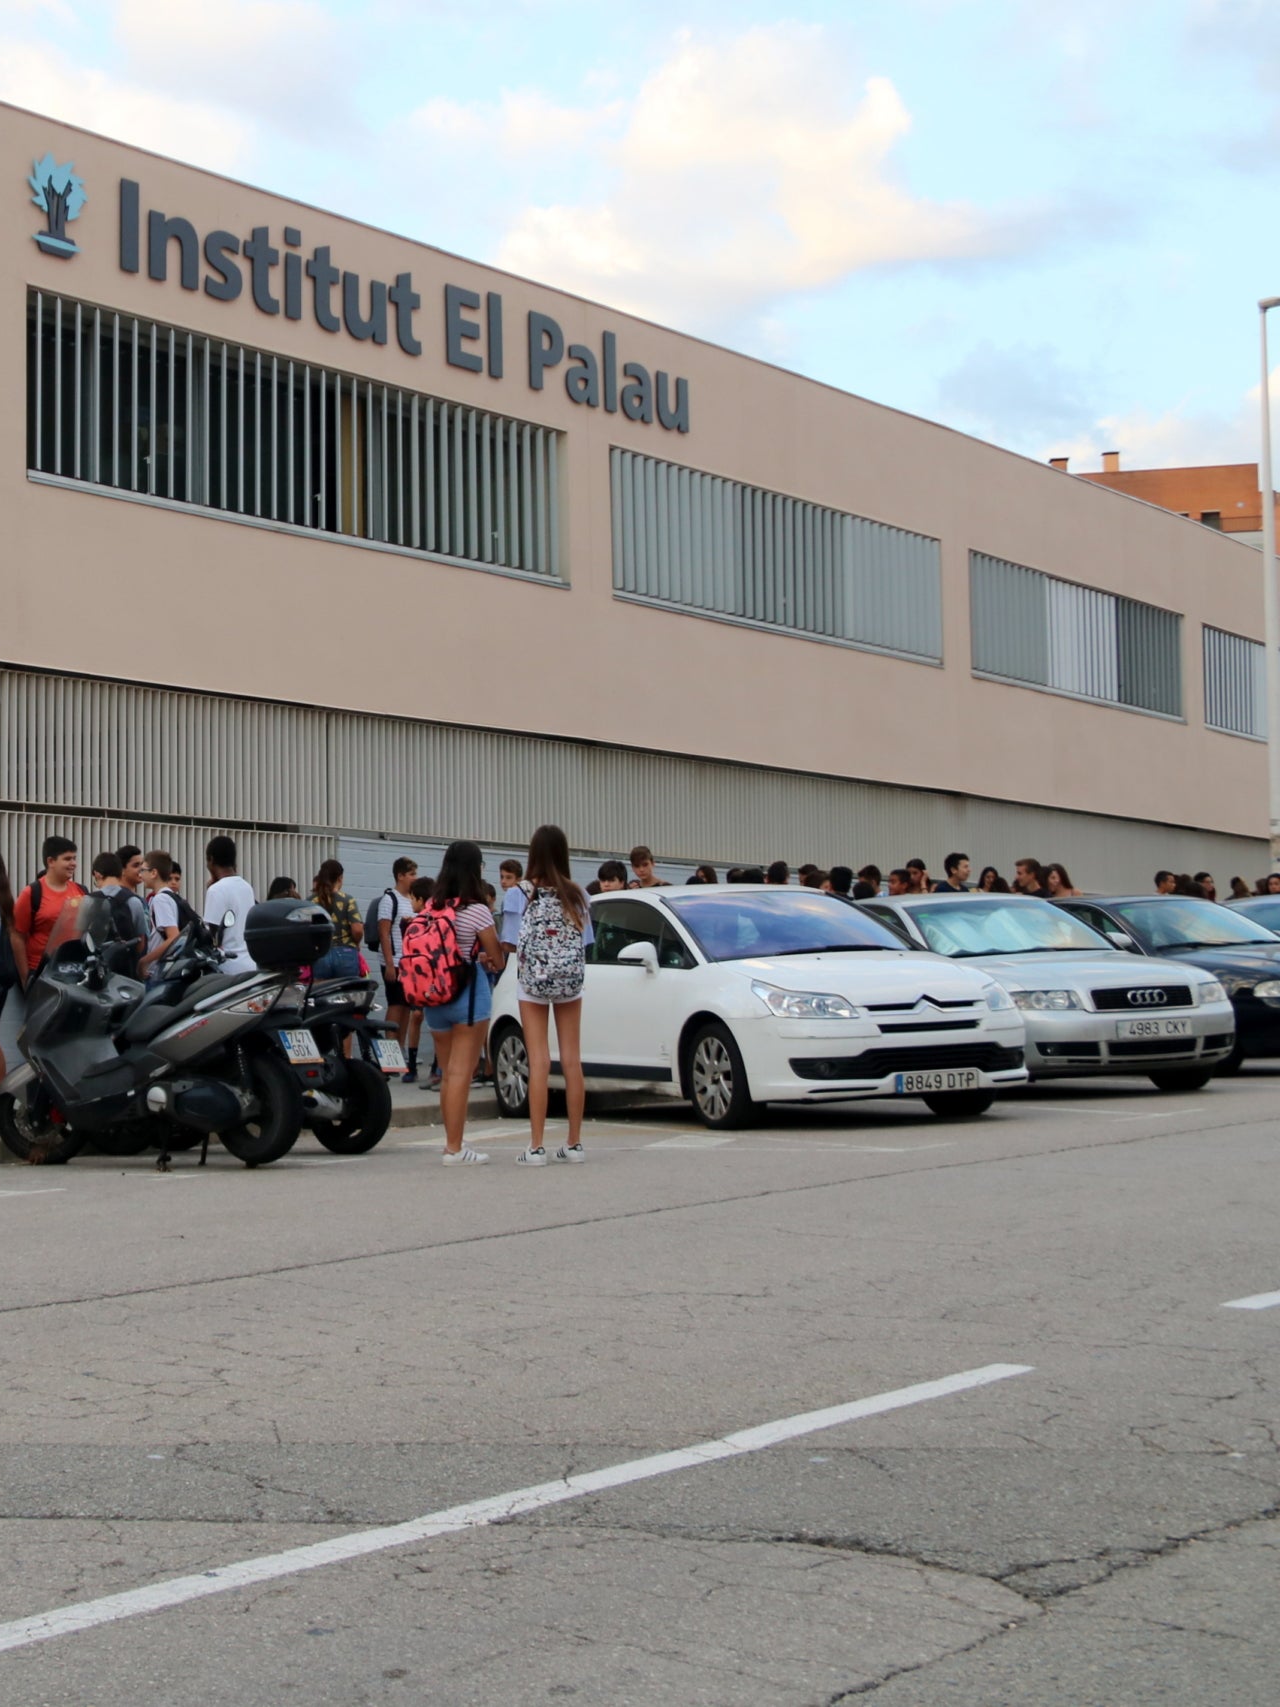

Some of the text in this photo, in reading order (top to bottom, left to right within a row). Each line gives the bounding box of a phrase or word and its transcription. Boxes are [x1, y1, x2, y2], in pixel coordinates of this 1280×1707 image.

[120, 178, 690, 434] Institut El Palau
[1129, 1020, 1187, 1036] 4983 CKY
[286, 1031, 312, 1043] 7471
[292, 1045, 313, 1057] GDX
[905, 1072, 975, 1091] 8849 DTP
